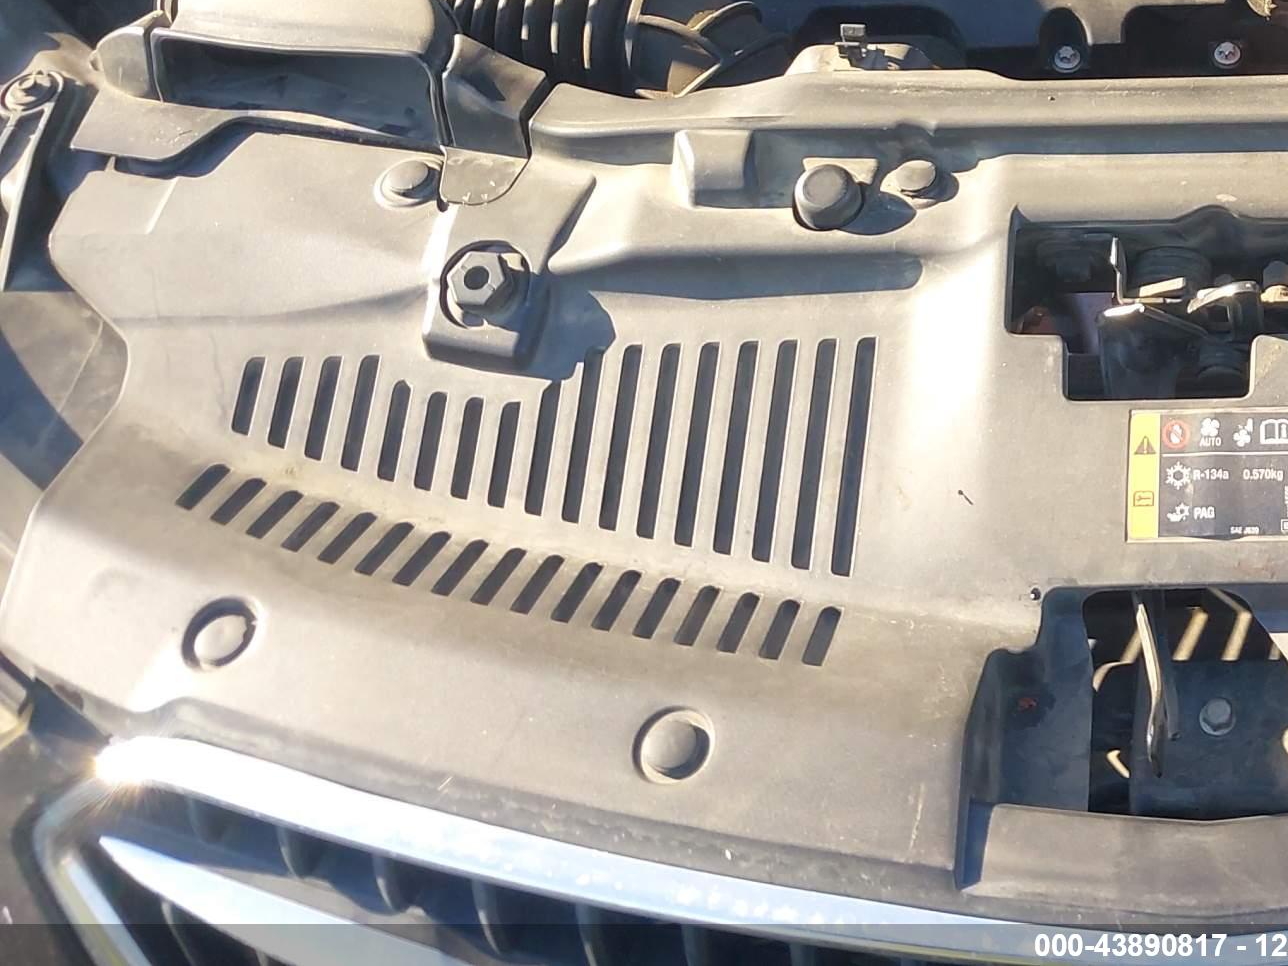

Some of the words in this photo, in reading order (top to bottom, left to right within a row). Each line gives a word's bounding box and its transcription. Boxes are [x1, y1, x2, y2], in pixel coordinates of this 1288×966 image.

[1199, 437, 1222, 447] AUTO
[1193, 469, 1229, 481] R-134a
[1243, 468, 1284, 482] 0.570kg
[1193, 506, 1215, 519] PAG
